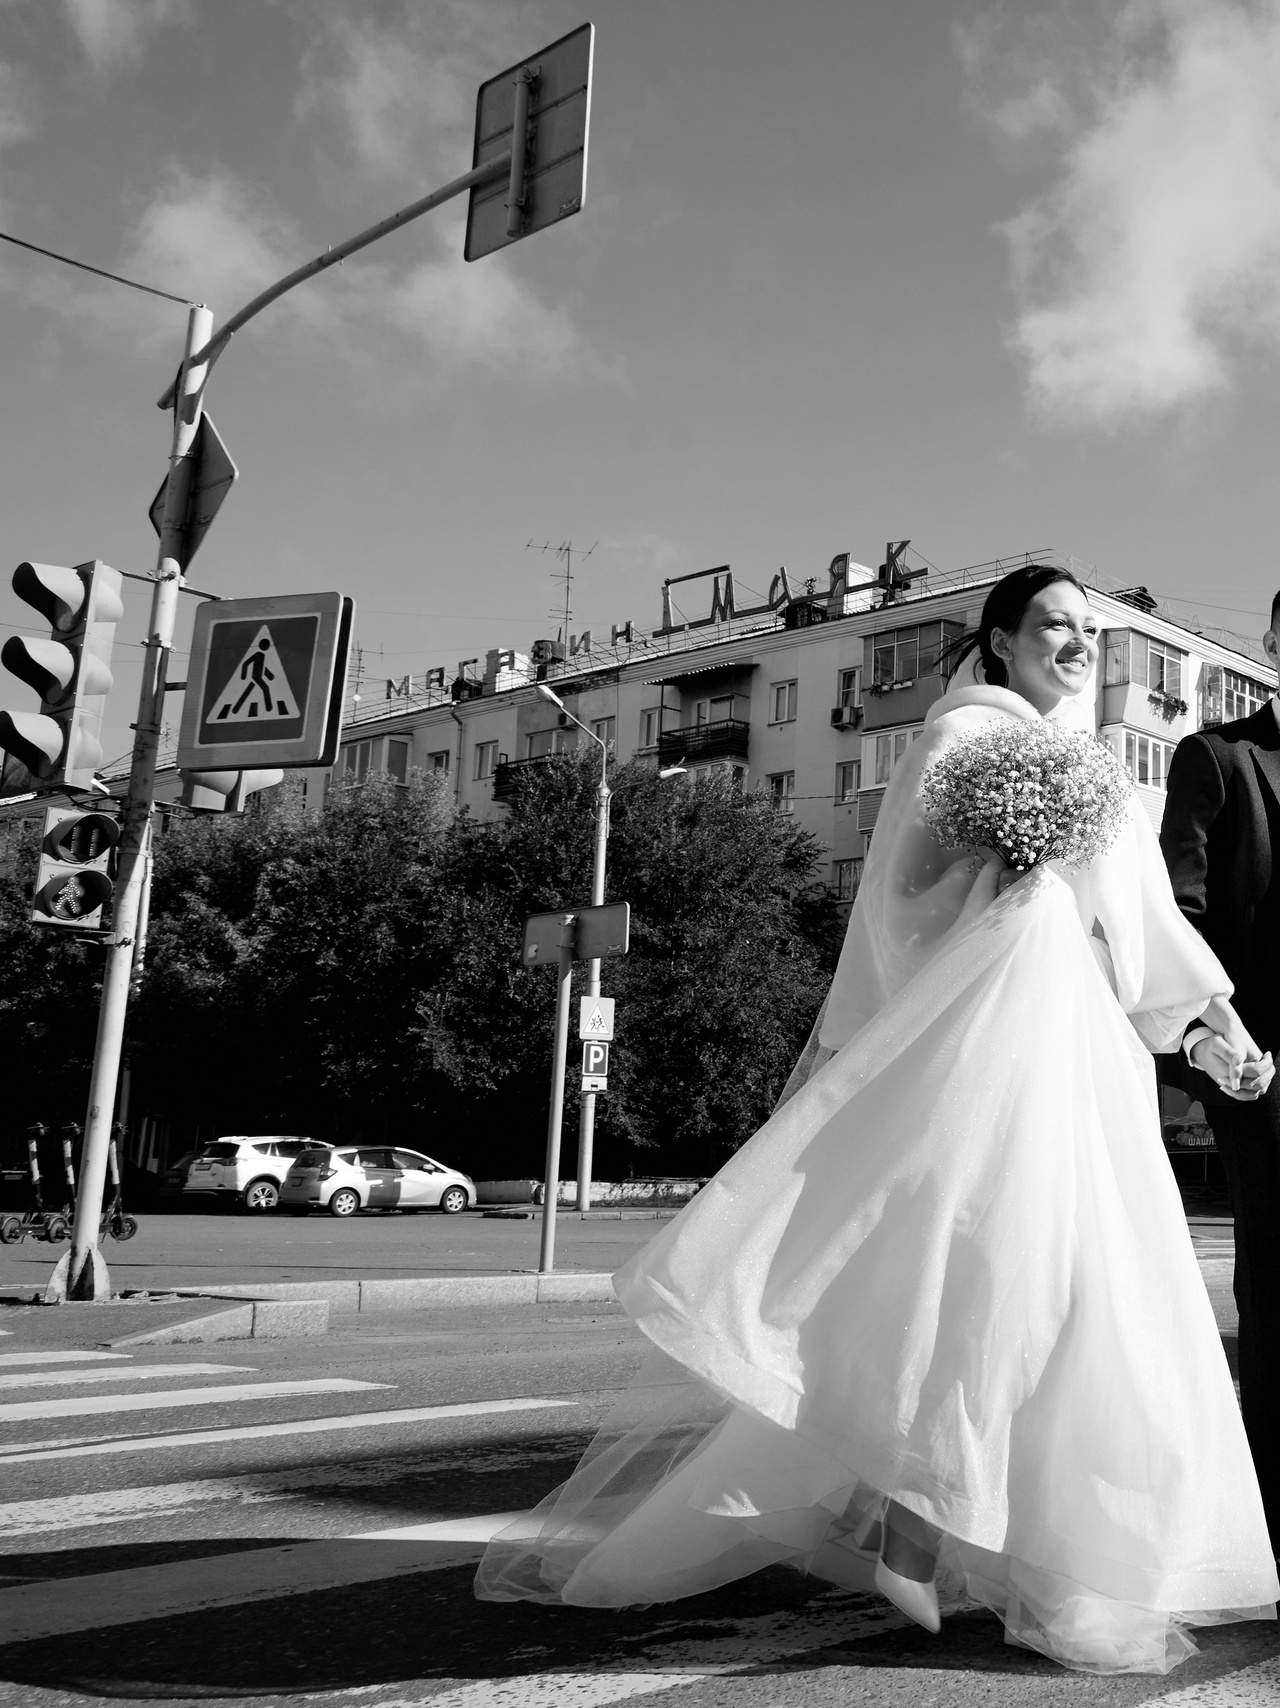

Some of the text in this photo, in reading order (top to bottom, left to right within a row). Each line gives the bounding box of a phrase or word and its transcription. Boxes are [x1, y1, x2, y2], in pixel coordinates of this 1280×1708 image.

[386, 620, 633, 699] МАГАЗИН
[589, 1045, 604, 1072] P
[1188, 1137, 1216, 1147] ШАШЛ
